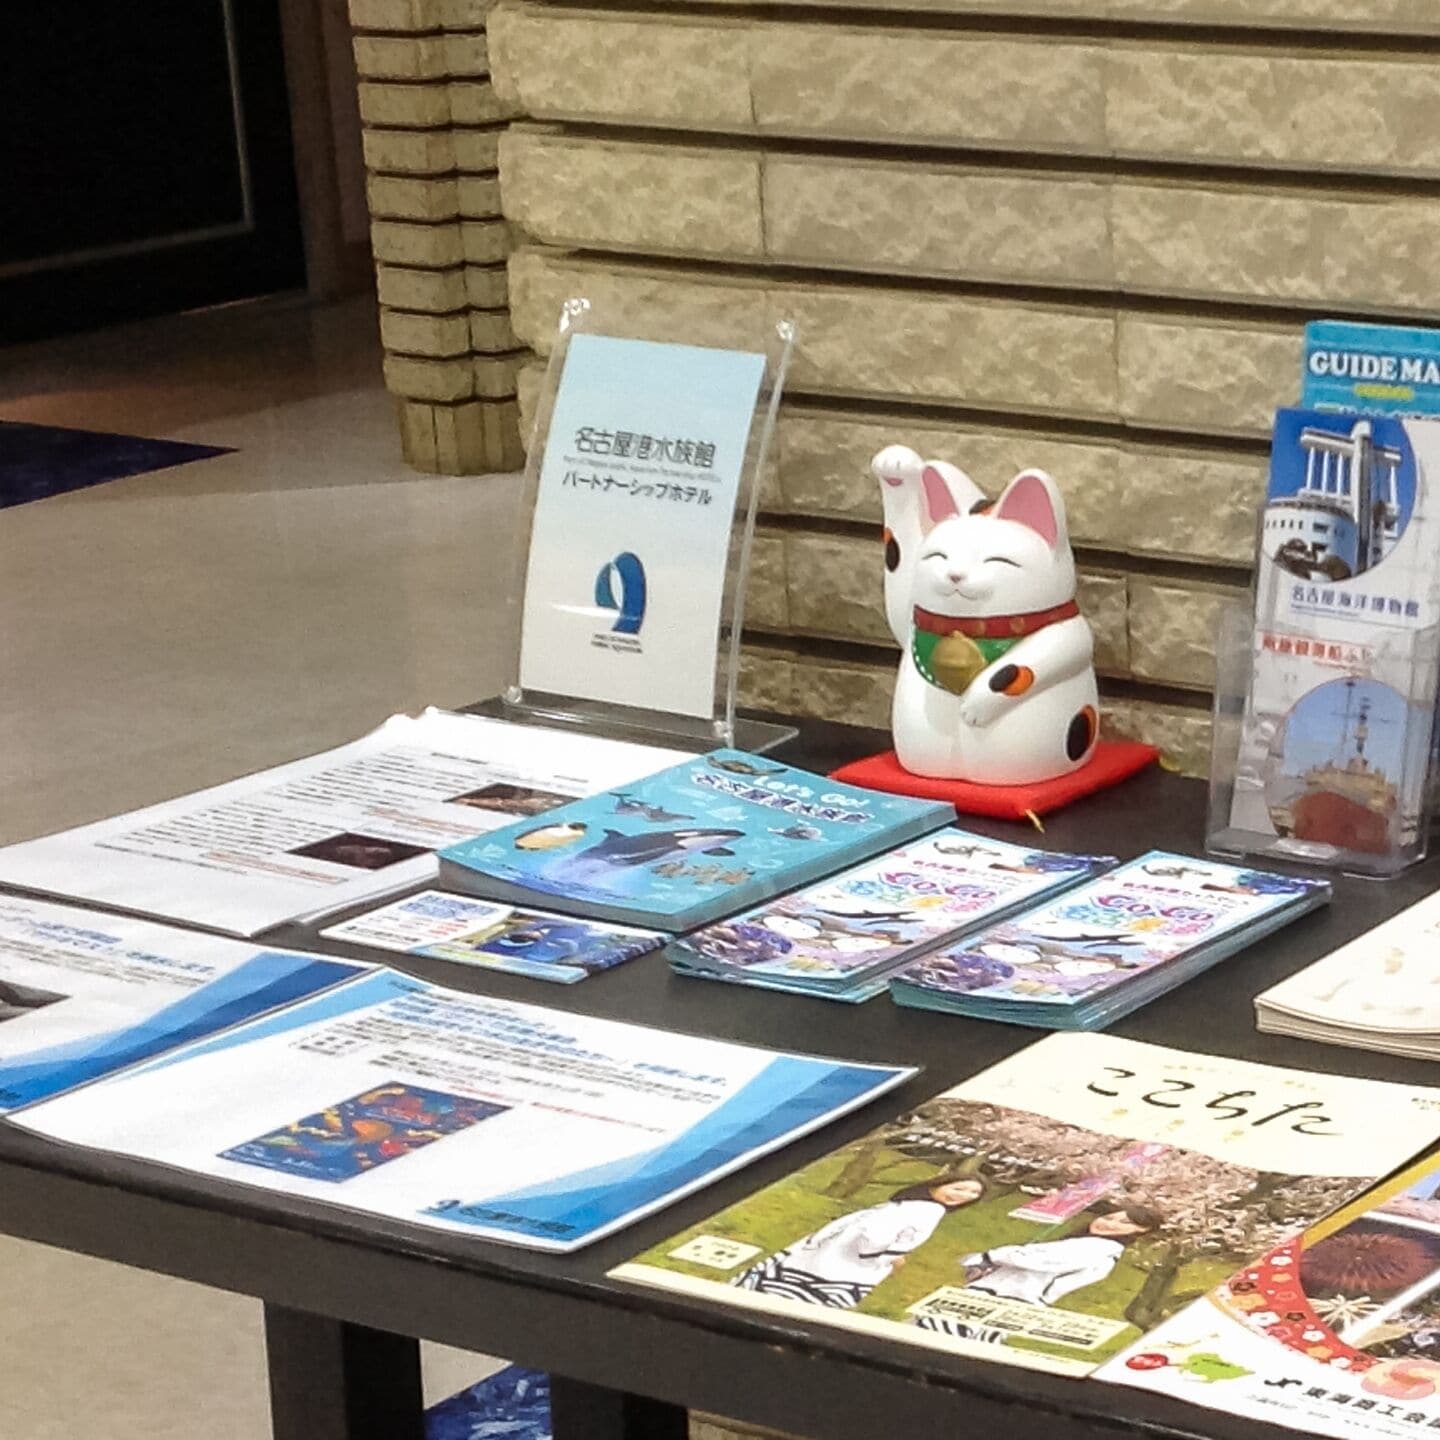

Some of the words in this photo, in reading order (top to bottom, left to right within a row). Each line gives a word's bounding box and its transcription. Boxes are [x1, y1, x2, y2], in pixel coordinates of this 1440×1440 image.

[1309, 350, 1397, 380] GUIDE
[574, 426, 717, 469] 名古屋港水族館
[562, 469, 713, 507] パートナーシップホテル
[1086, 1065, 1344, 1138] ここちた
